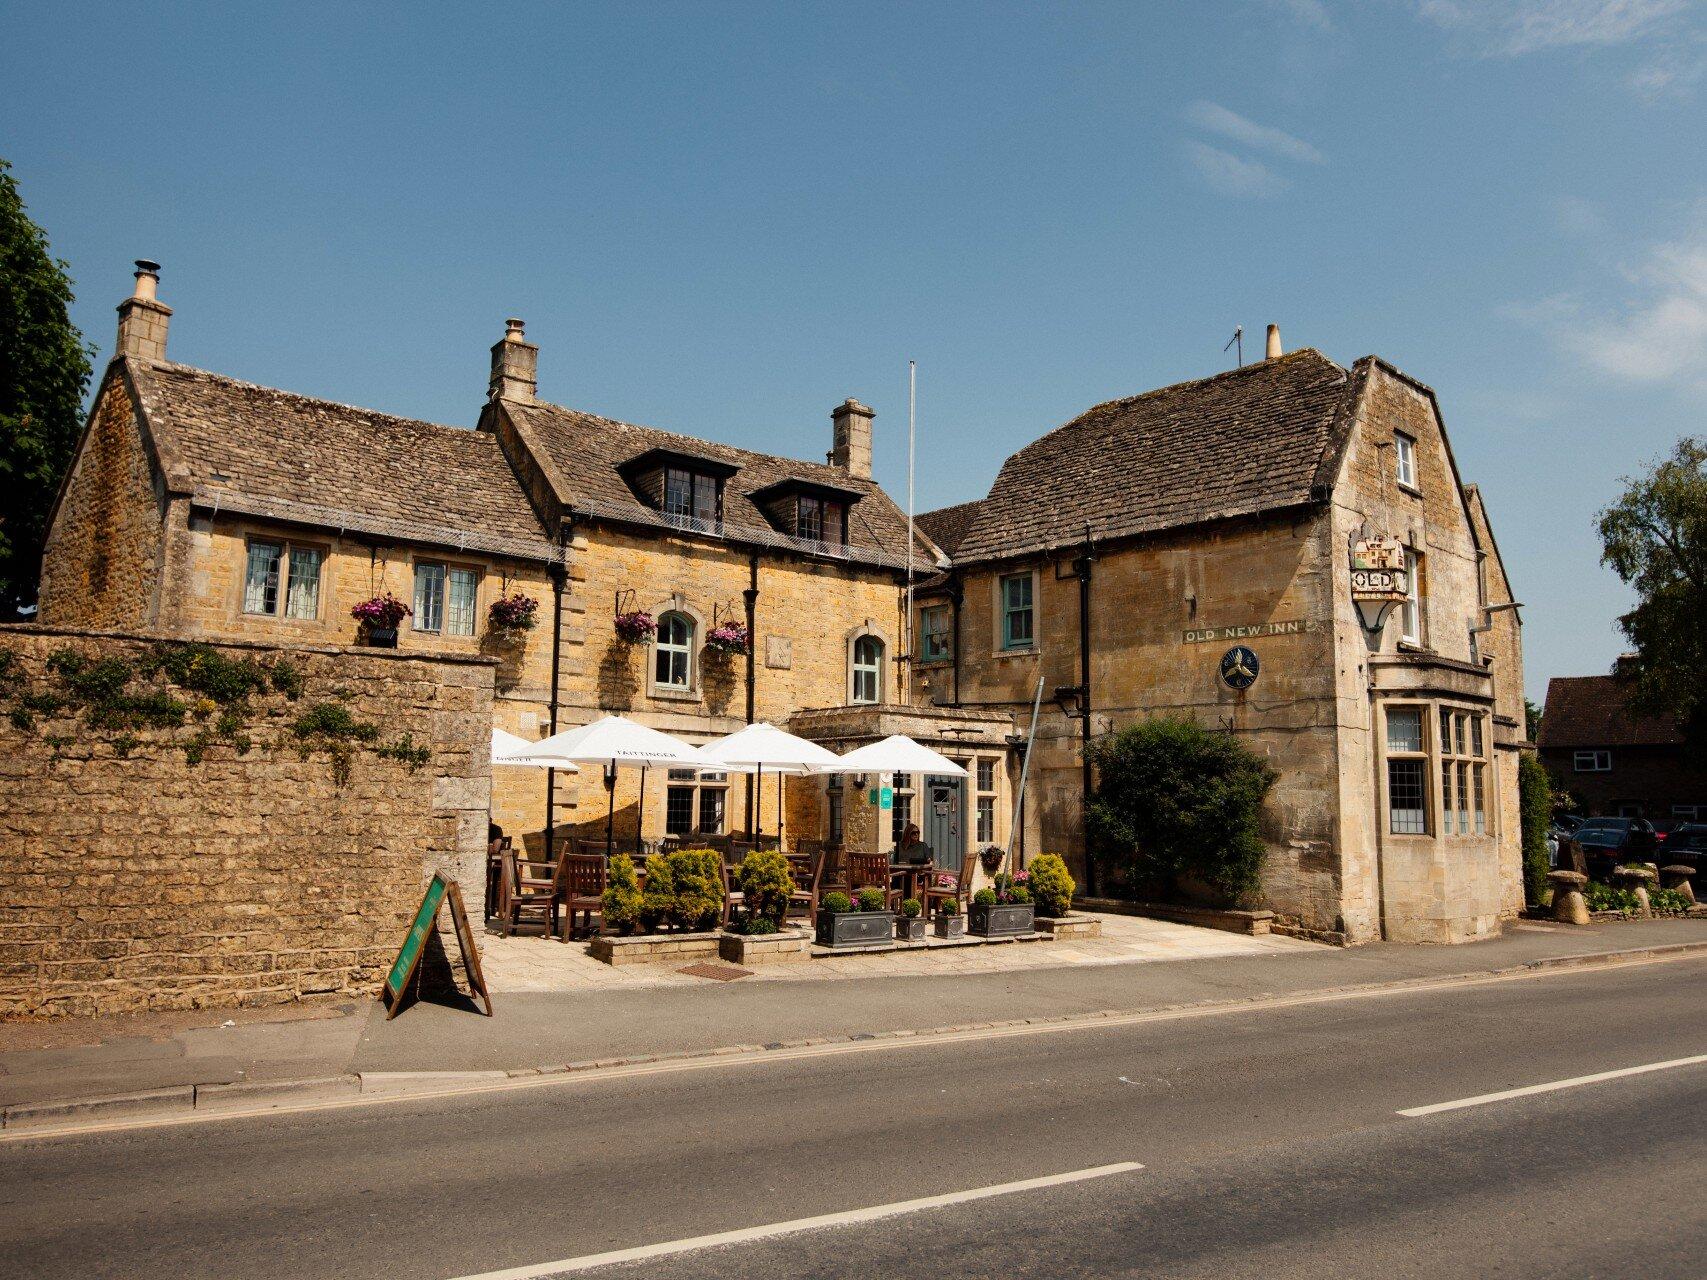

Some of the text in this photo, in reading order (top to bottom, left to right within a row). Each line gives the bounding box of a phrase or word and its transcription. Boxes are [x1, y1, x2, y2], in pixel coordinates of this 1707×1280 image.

[1355, 572, 1391, 586] OLD
[1186, 622, 1298, 642] OLD NEW INN
[617, 750, 677, 758] TAITTINGER
